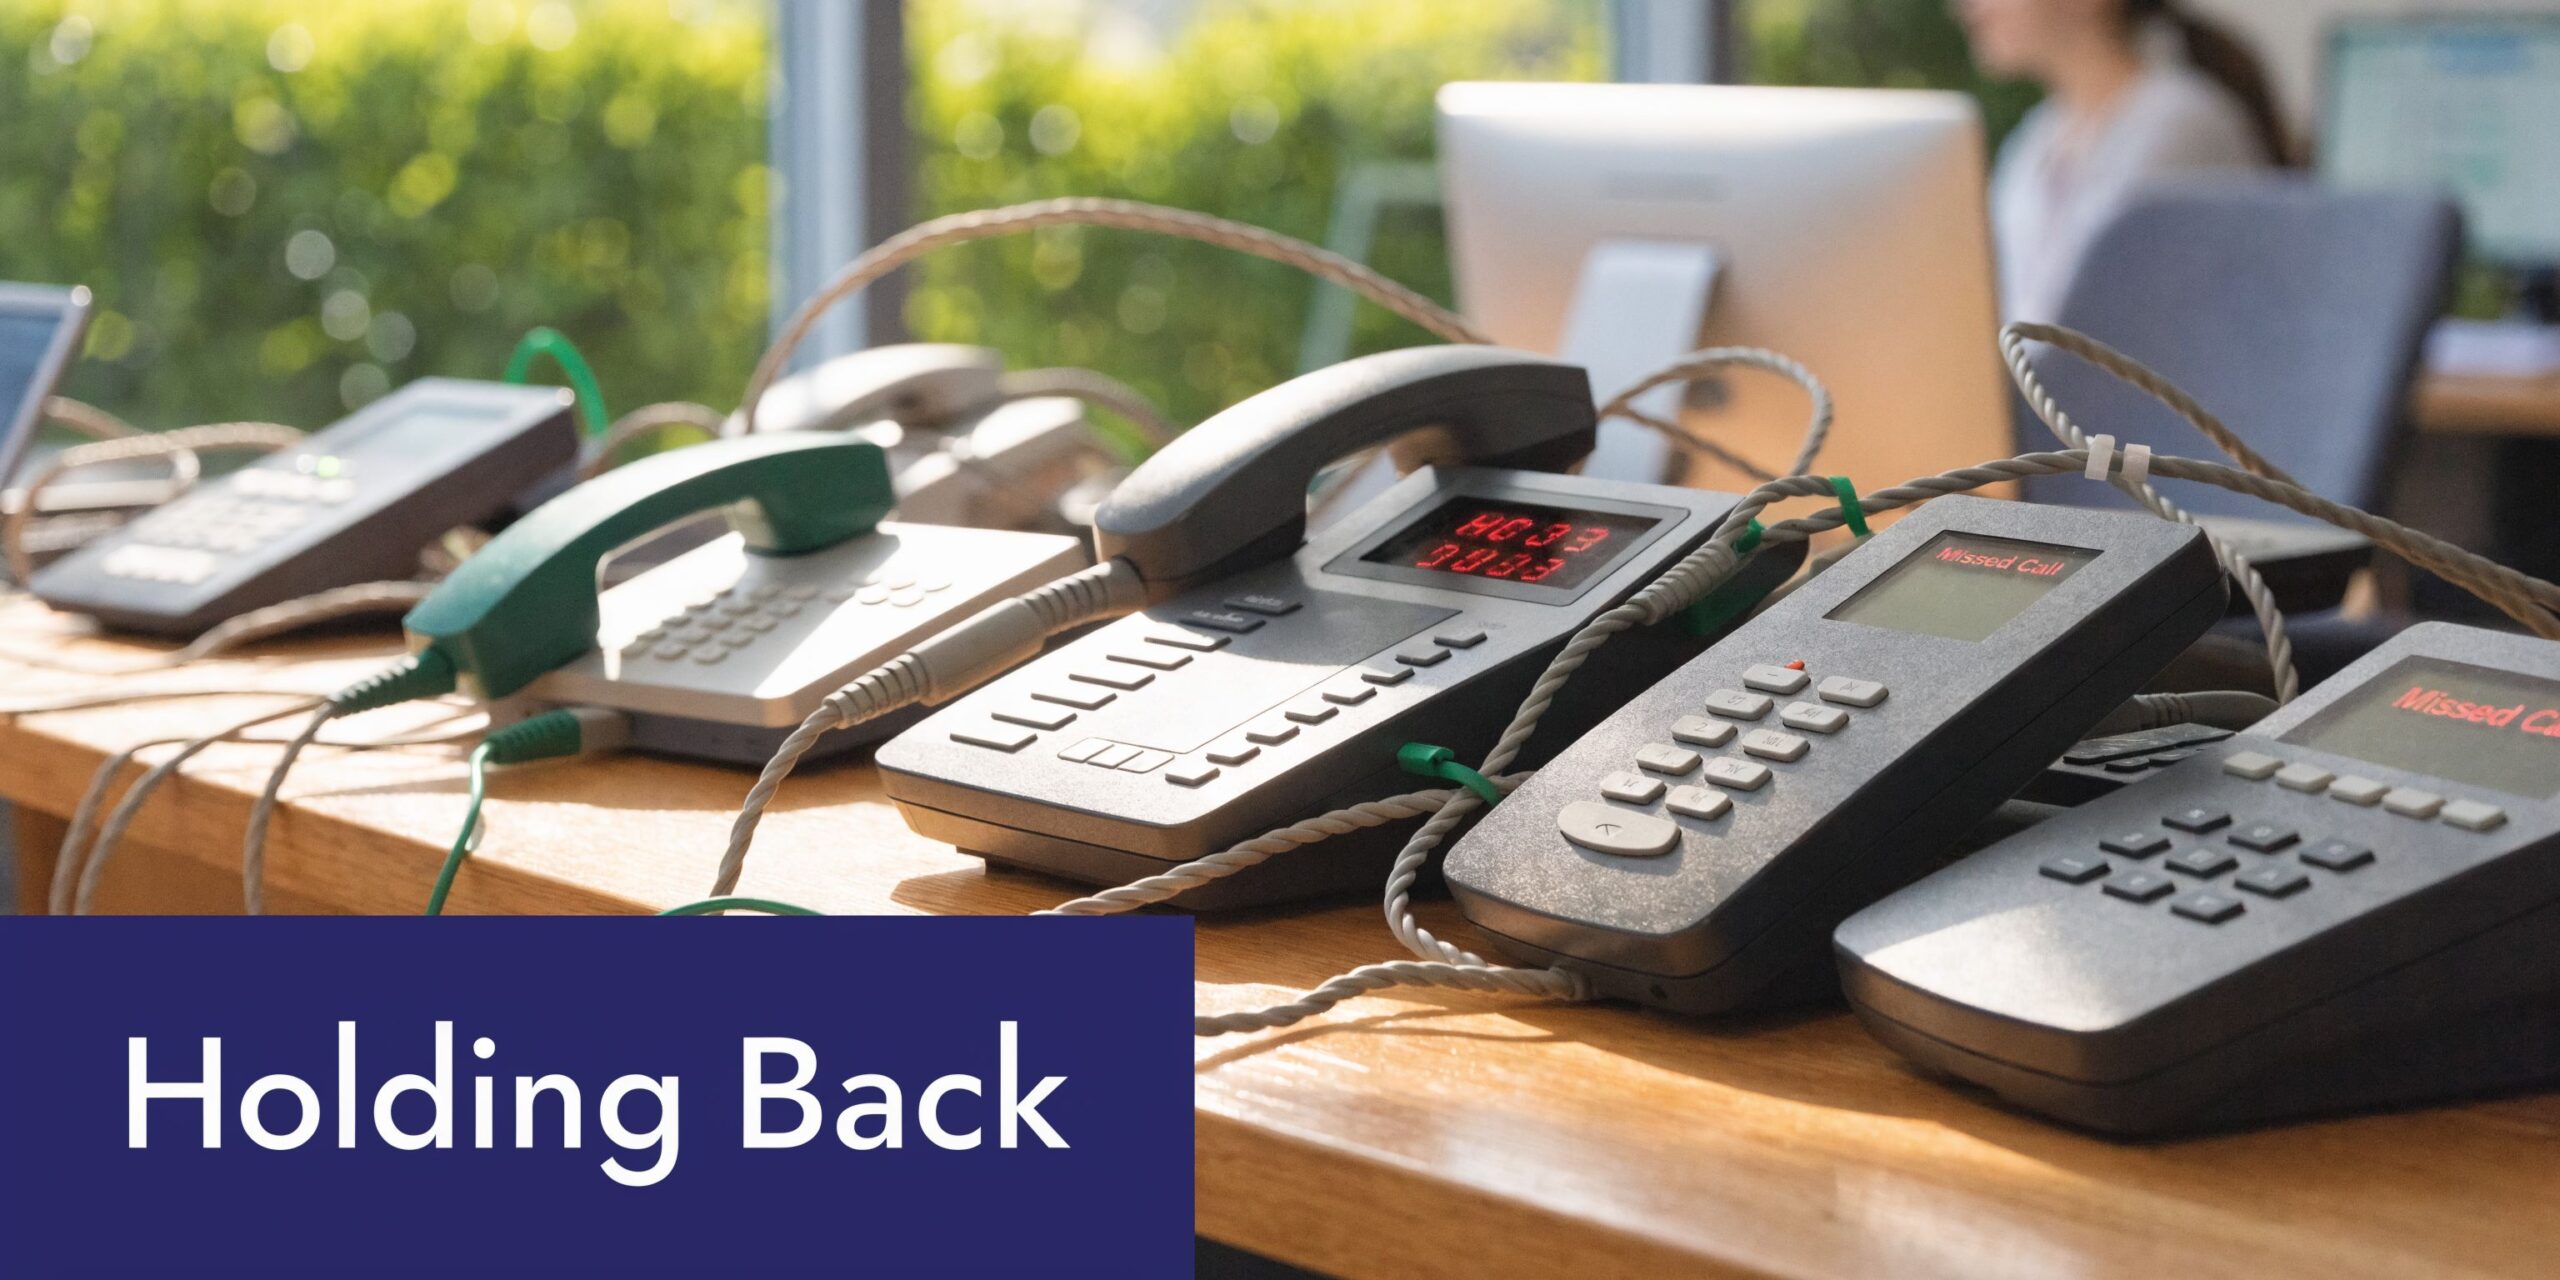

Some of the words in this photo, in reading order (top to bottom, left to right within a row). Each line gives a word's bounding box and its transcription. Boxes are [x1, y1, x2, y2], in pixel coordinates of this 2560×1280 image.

[1935, 545, 2018, 570] Missed
[2017, 558, 2065, 577] Call
[2392, 687, 2526, 728] Missed
